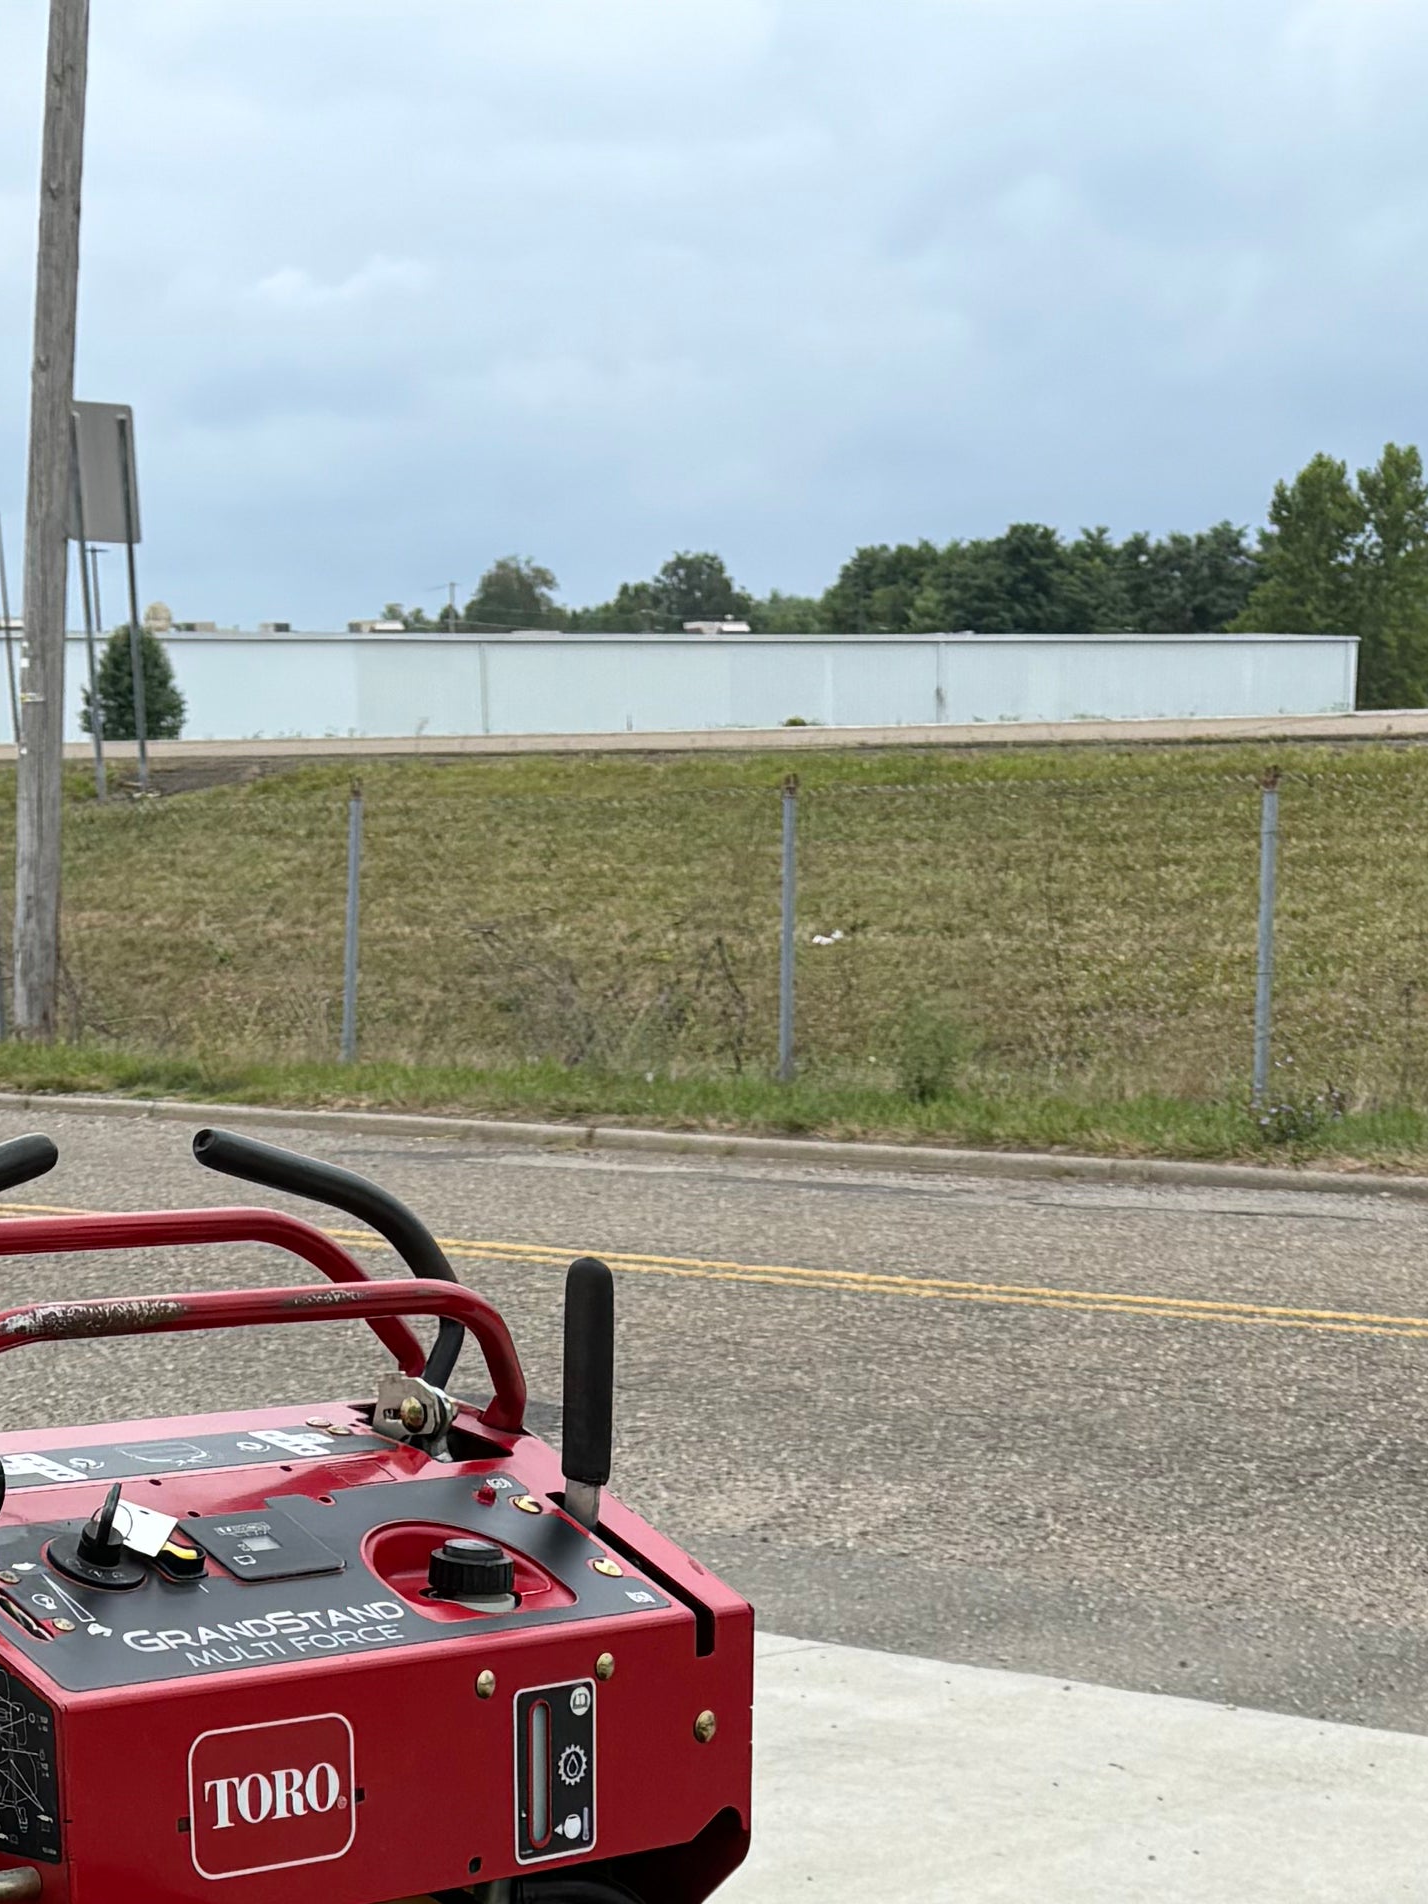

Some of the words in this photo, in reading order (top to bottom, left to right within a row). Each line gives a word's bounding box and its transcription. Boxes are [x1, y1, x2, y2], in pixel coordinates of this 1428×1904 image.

[185, 1640, 286, 1667] MULTI
[288, 1623, 404, 1653] FORCE
[204, 1762, 340, 1830] TORO
